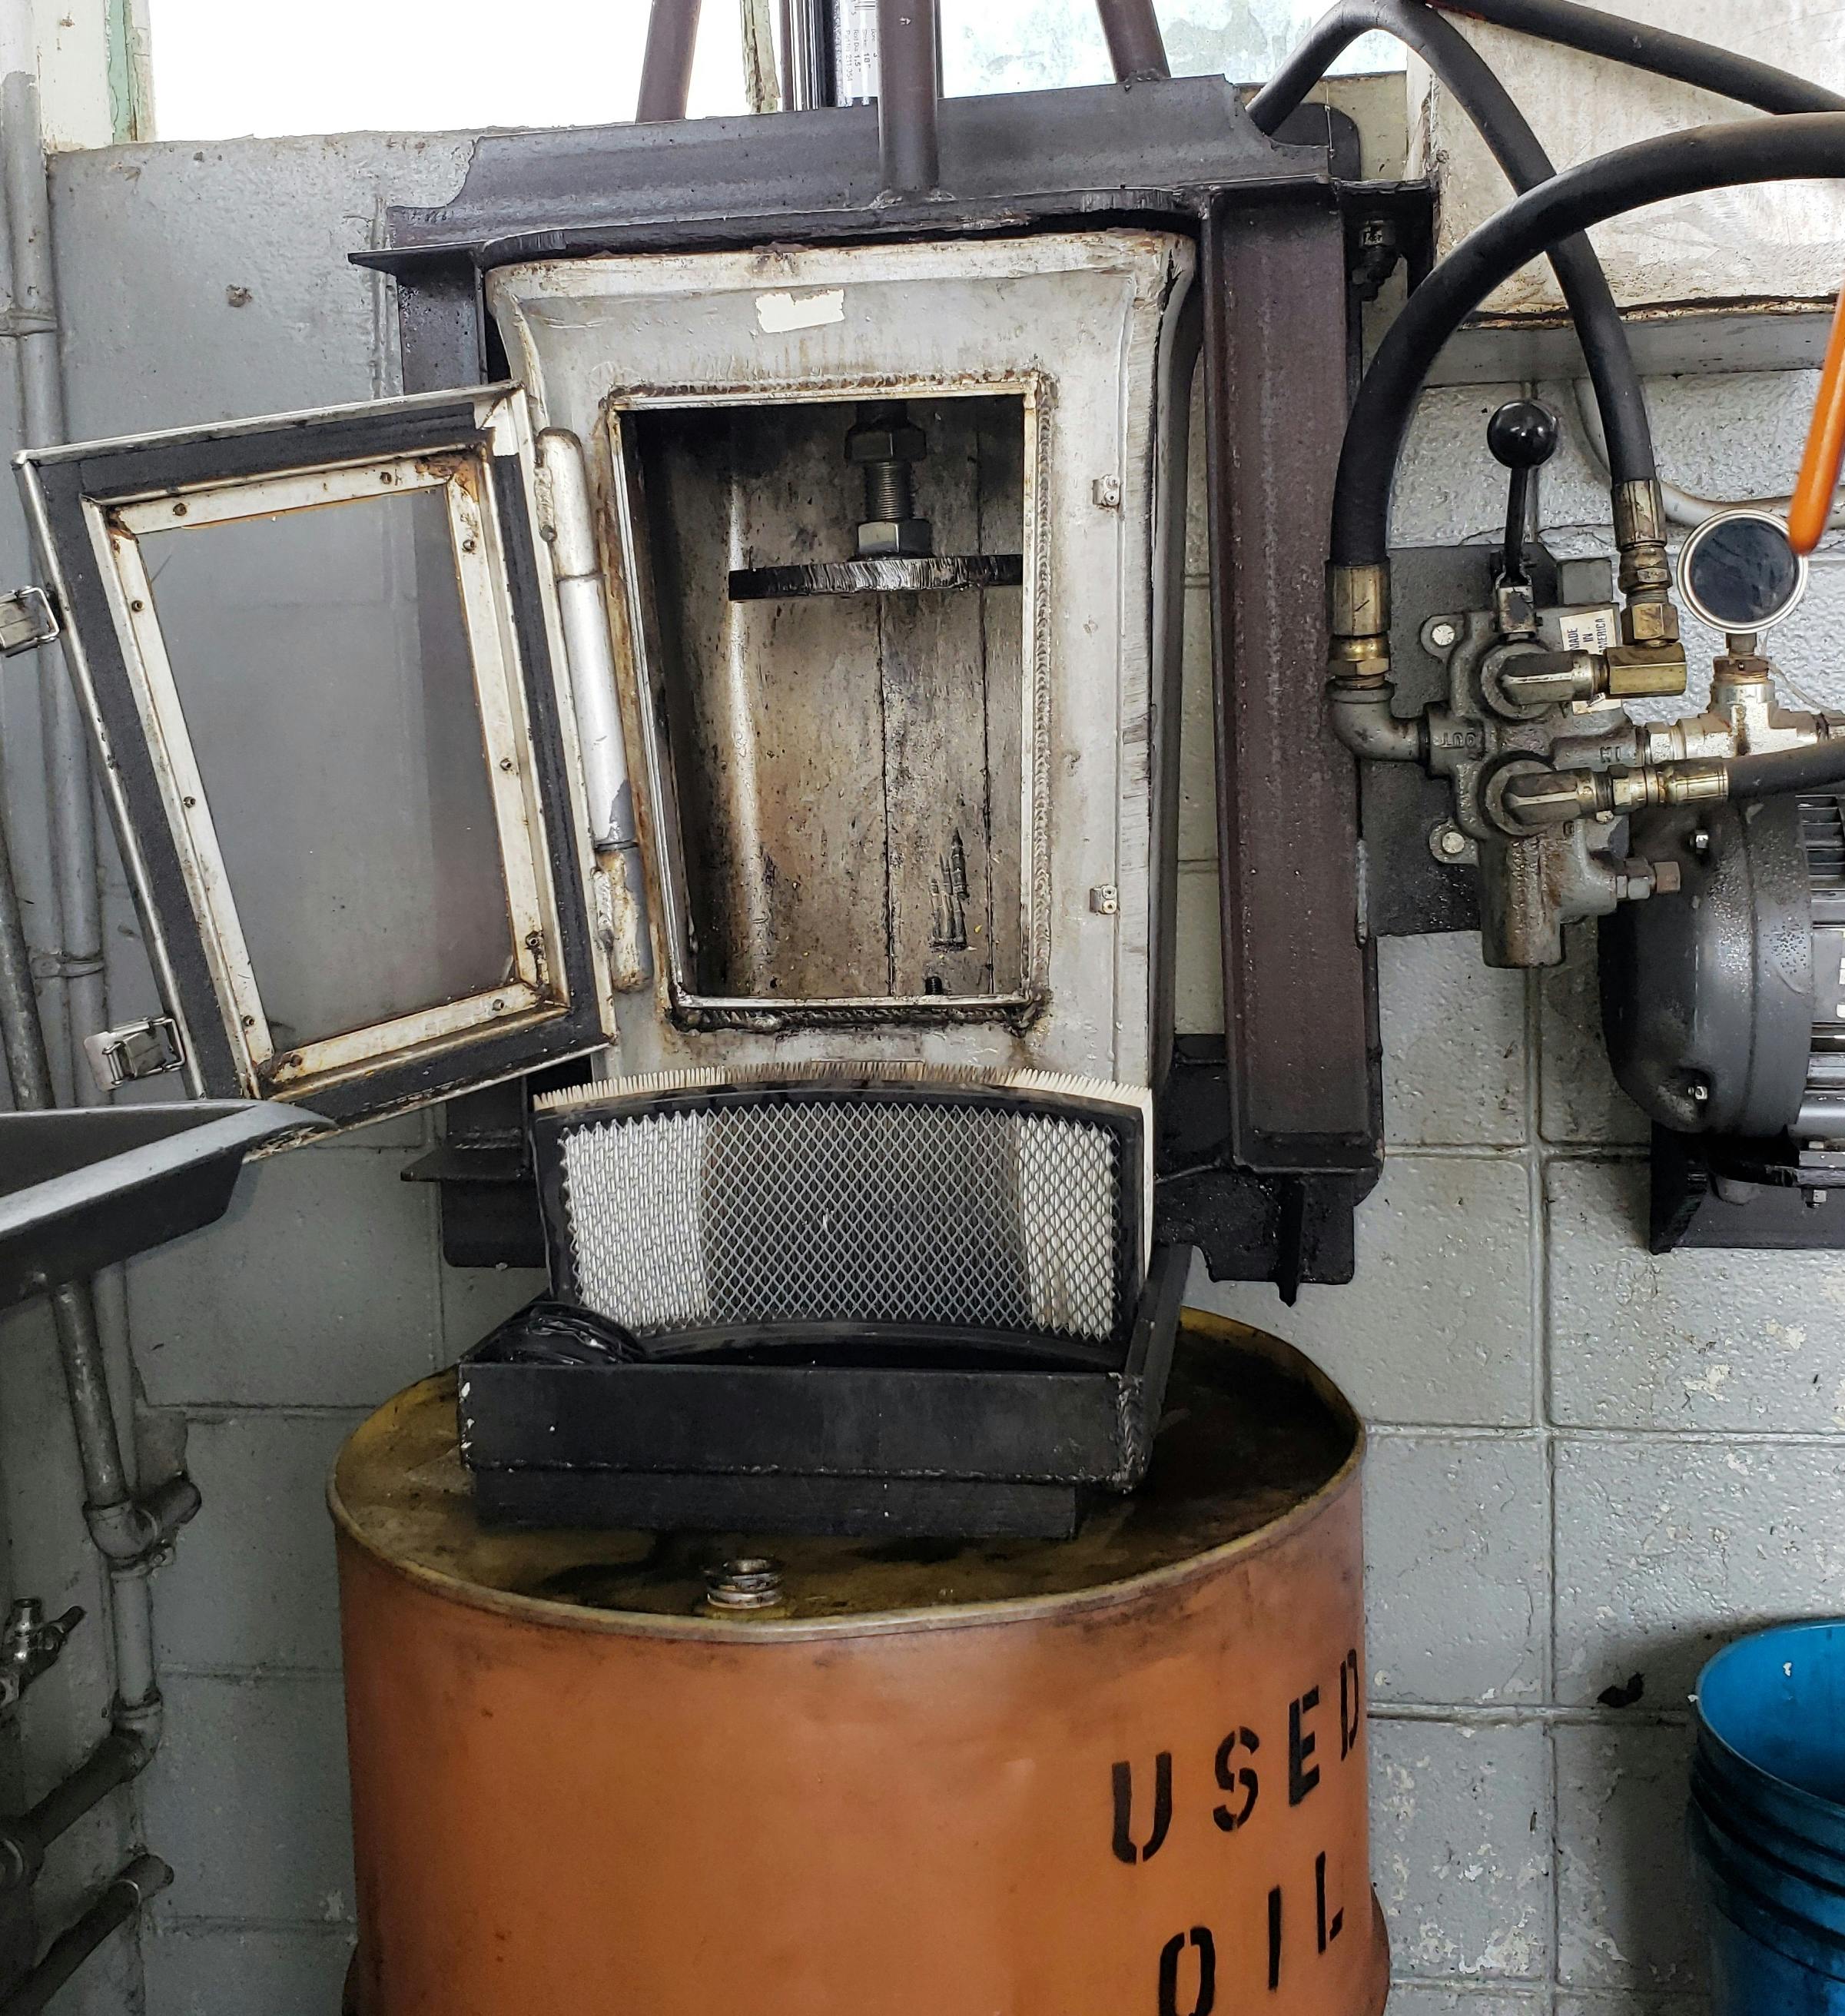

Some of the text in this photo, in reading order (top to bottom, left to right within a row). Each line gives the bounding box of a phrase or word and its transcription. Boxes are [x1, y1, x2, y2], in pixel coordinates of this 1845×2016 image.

[1568, 627, 1580, 650] MADE
[1583, 633, 1594, 643] IN
[1112, 1649, 1359, 1865] USED
[1159, 1851, 1344, 2016] OIL
